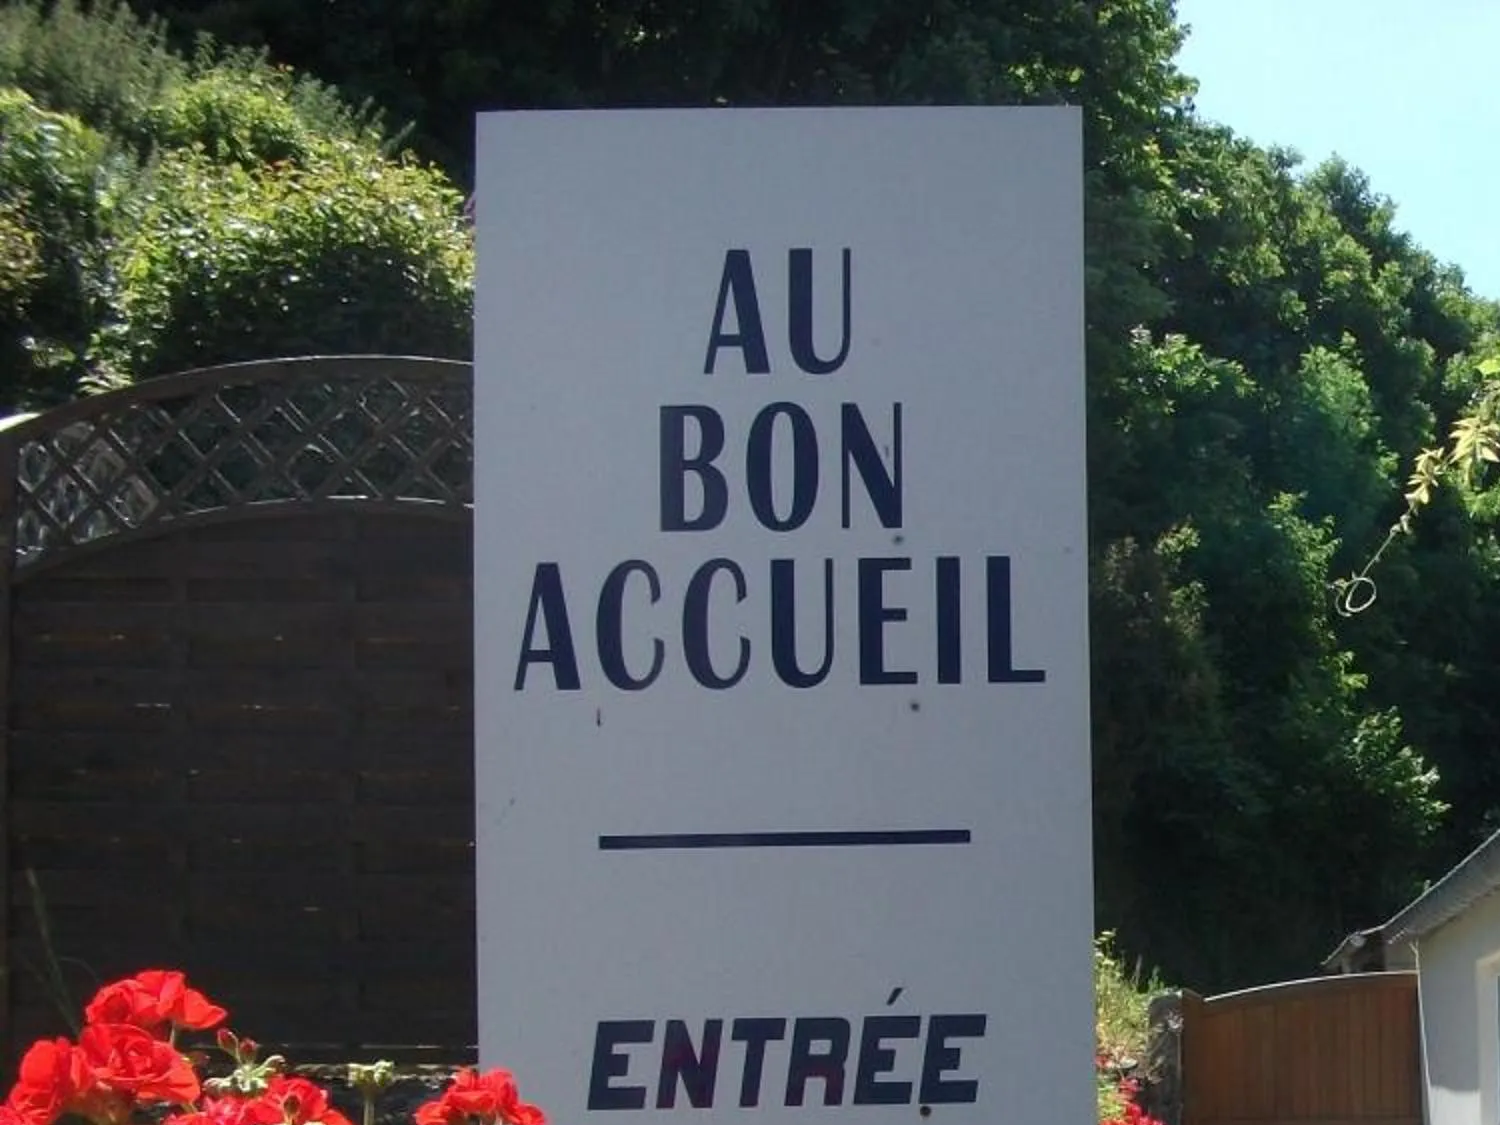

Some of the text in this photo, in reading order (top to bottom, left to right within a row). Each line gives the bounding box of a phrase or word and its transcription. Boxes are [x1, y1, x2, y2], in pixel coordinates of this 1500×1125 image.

[702, 246, 853, 376] AU
[658, 400, 904, 533] BON
[512, 554, 1048, 692] ACCUEIL
[586, 986, 988, 1112] ENTRÉE
